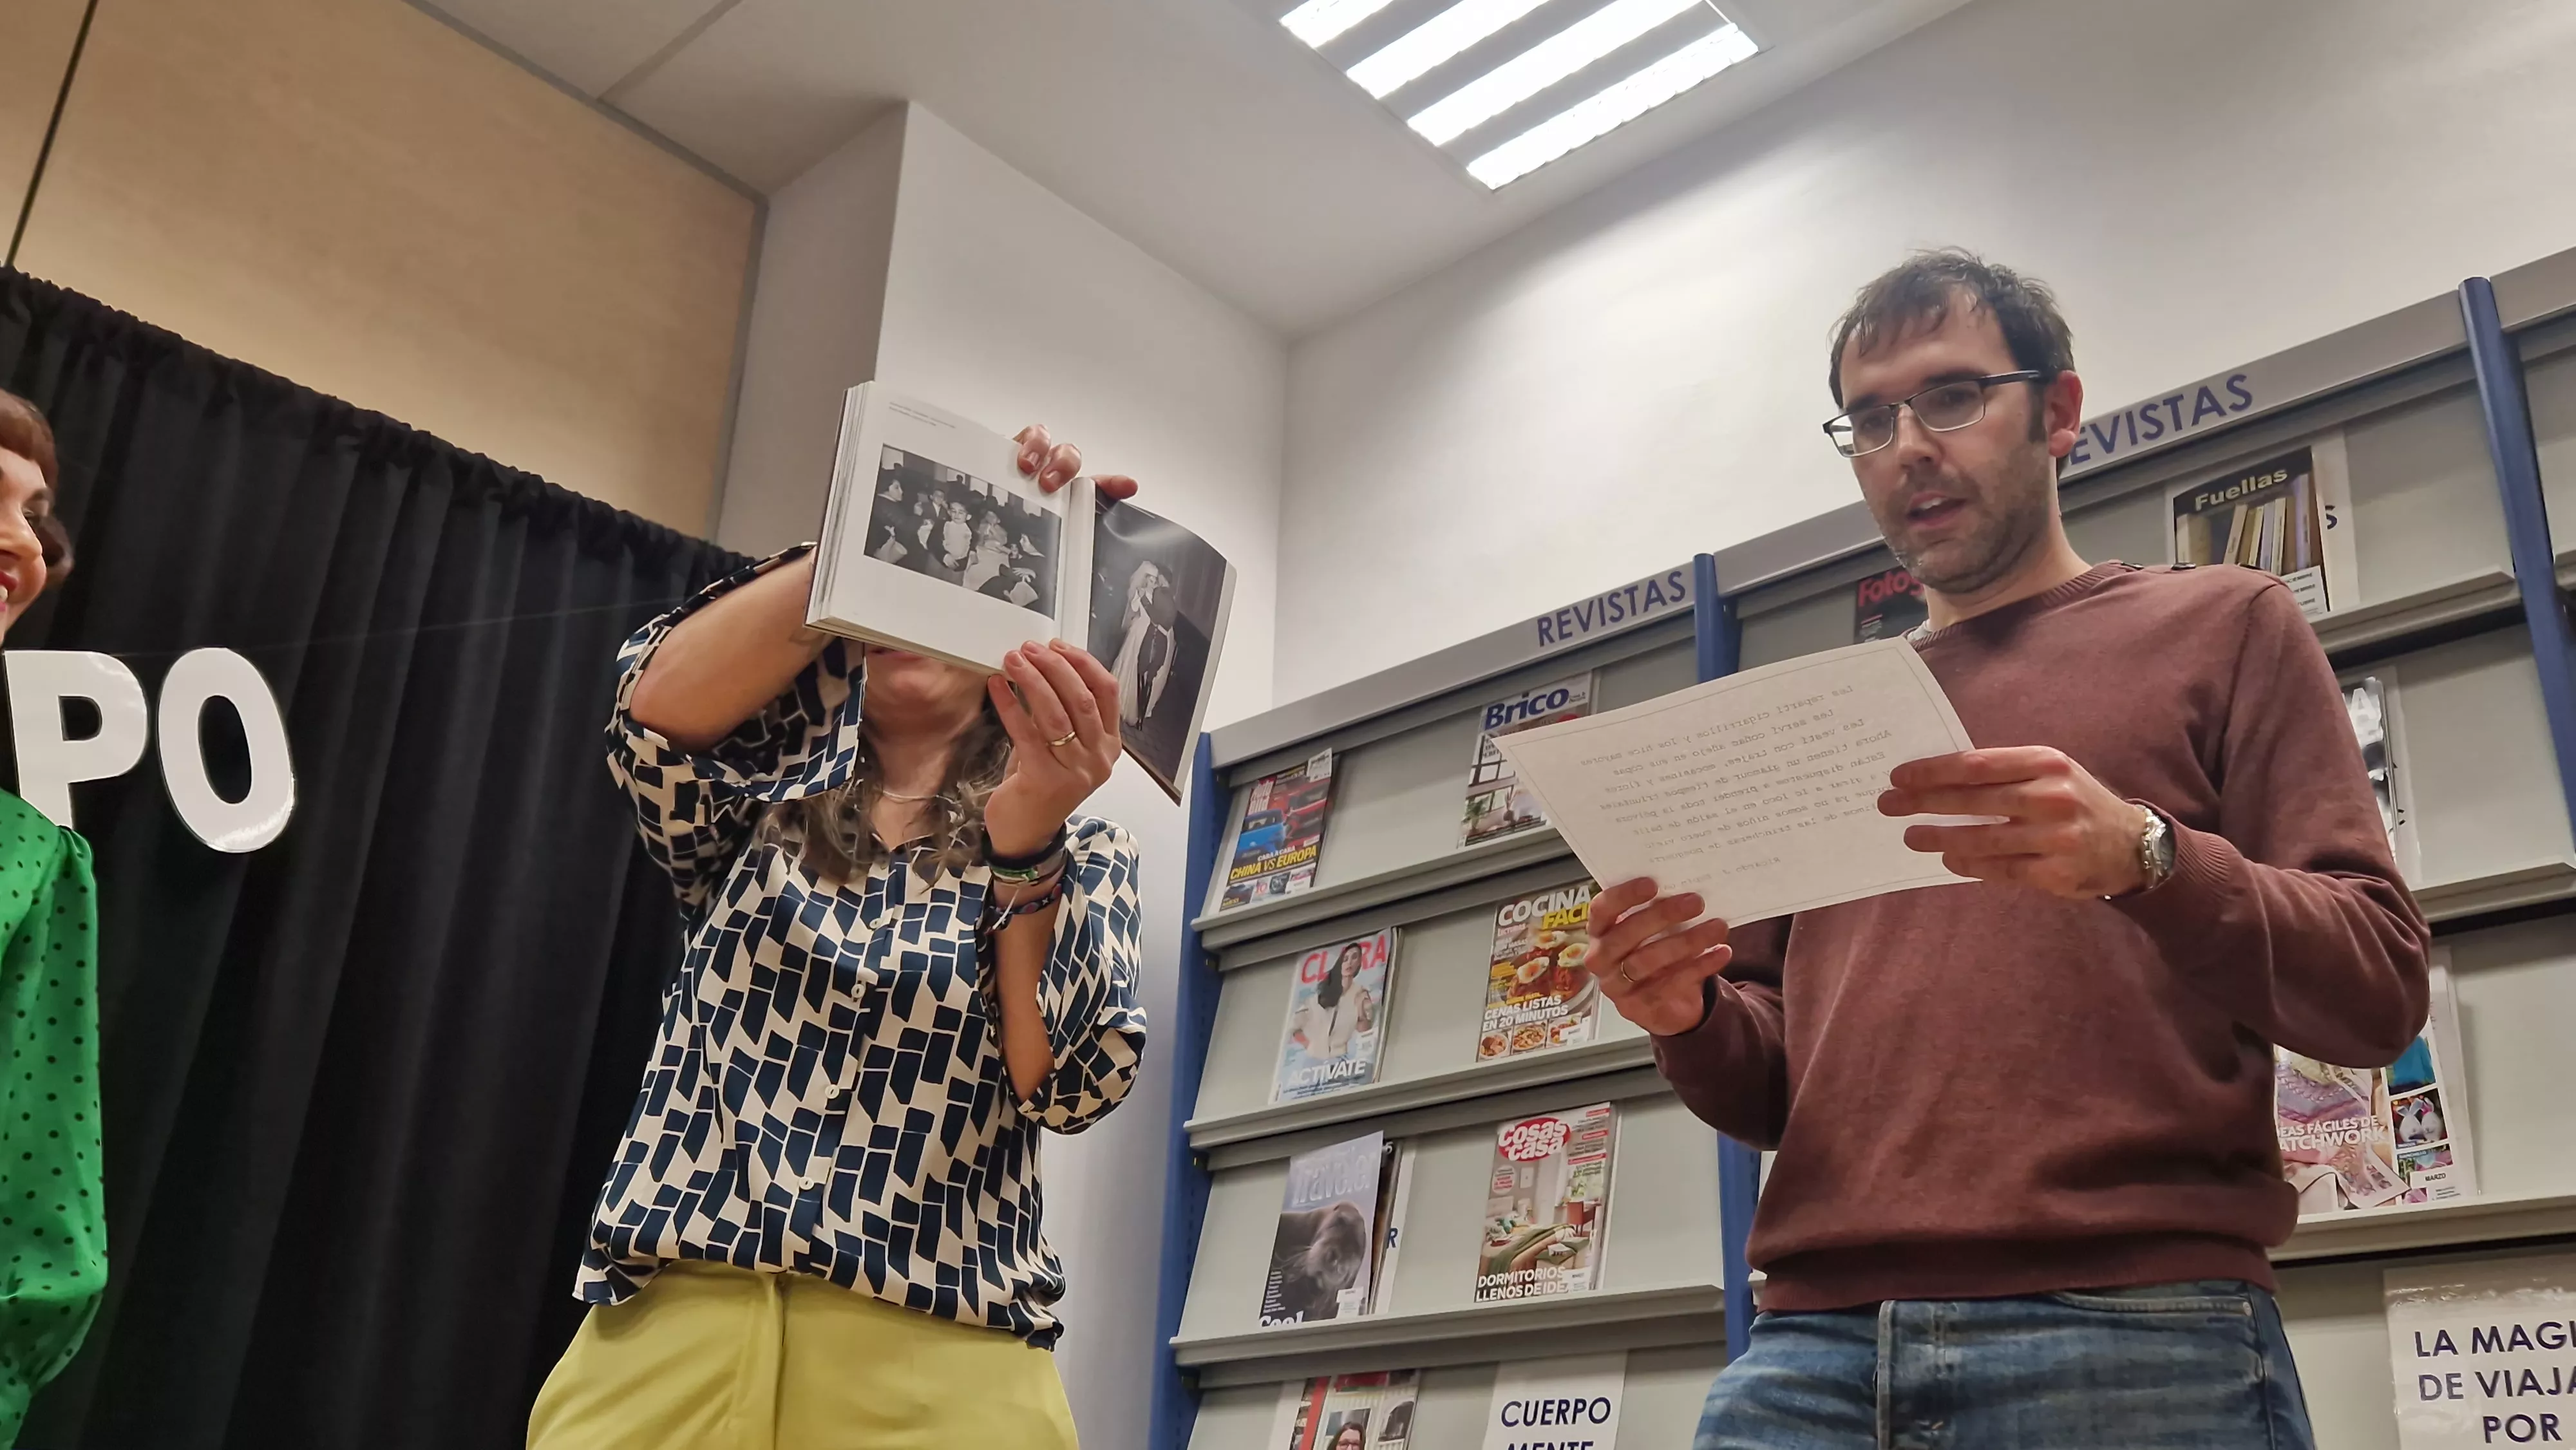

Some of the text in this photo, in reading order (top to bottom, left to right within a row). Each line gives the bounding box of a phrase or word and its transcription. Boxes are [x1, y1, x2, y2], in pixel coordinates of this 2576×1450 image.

[2070, 375, 2253, 465] EVISTAS
[2195, 468, 2288, 511] Fuellas
[1858, 570, 1923, 607] Foto
[1537, 570, 1686, 647] REVISTAS
[1485, 688, 1569, 730] Brico
[1230, 845, 1317, 880] CHINA VS EUROPA
[1498, 885, 1591, 927] COCINA
[1542, 903, 1589, 930] FACI
[1482, 1004, 1569, 1031] EN 20 MINUTOS
[1484, 1003, 1520, 1020] CENAS
[1522, 995, 1561, 1011] LISTAS
[1288, 1058, 1367, 1086] ACTÍVATE
[1499, 1120, 1567, 1147] Cosas
[2278, 1115, 2378, 1138] EAS FÁCILES DE
[2279, 1125, 2385, 1153] ATCHWORK
[1508, 1137, 1564, 1161] casa
[1477, 1266, 1566, 1288] DORMITORIOS
[1475, 1285, 1523, 1302] LLENOS
[1524, 1282, 1541, 1297] DE
[1542, 1281, 1569, 1294] IDE
[2414, 1329, 2459, 1357] LA
[2418, 1372, 2464, 1401] DE
[1501, 1397, 1611, 1427] CUERPO
[2483, 1413, 2562, 1444] POR
